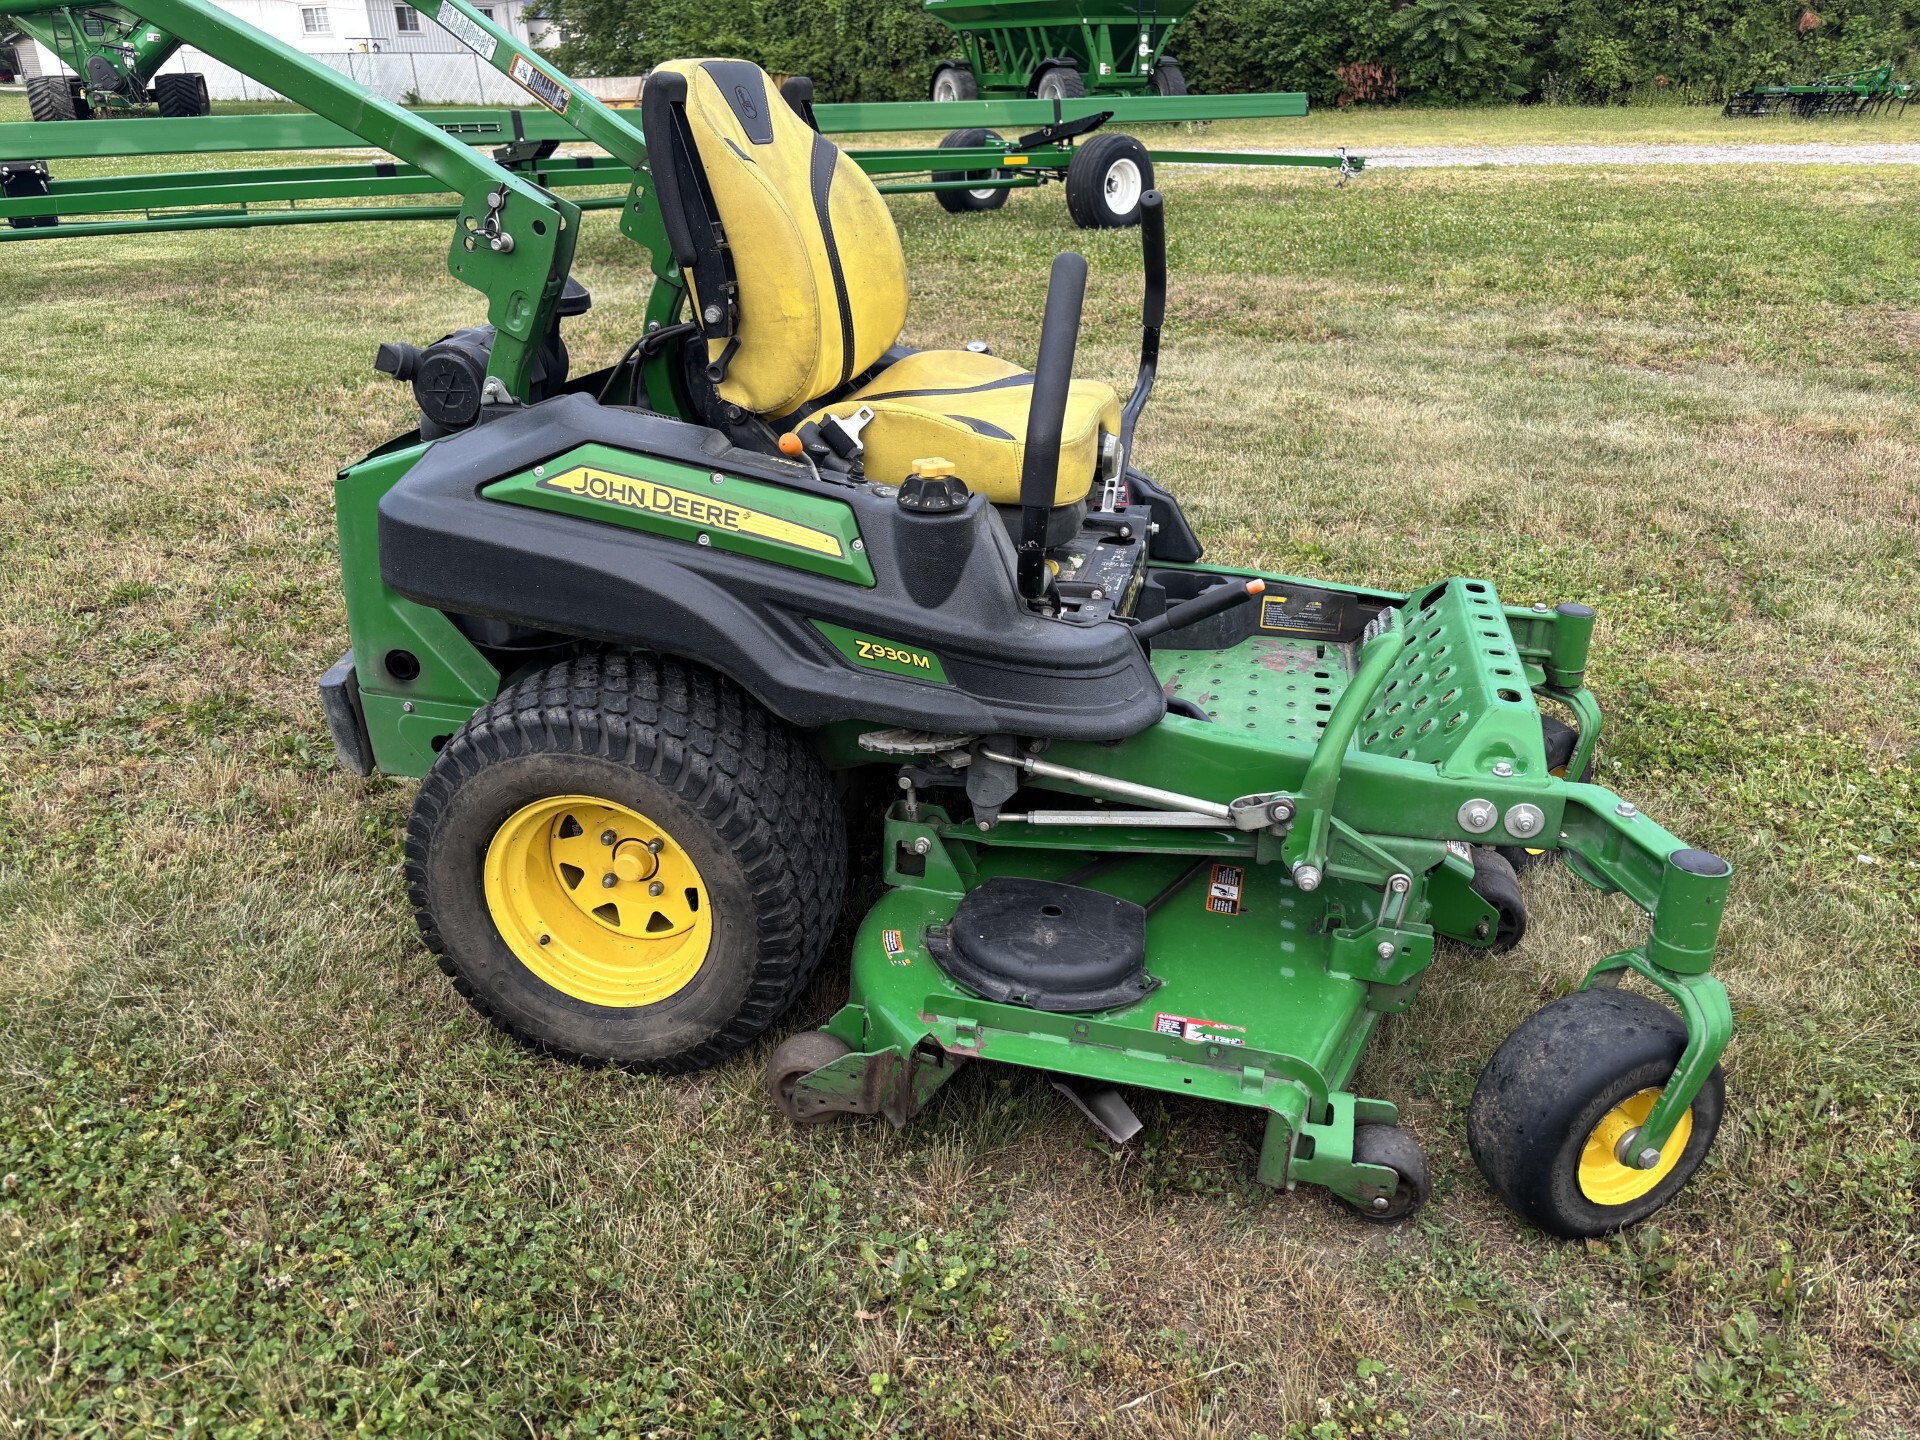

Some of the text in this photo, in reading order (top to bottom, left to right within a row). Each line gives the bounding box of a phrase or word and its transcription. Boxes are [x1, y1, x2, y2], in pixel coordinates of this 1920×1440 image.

[573, 471, 740, 529] JOHN DEERE
[854, 639, 931, 669] Z930M
